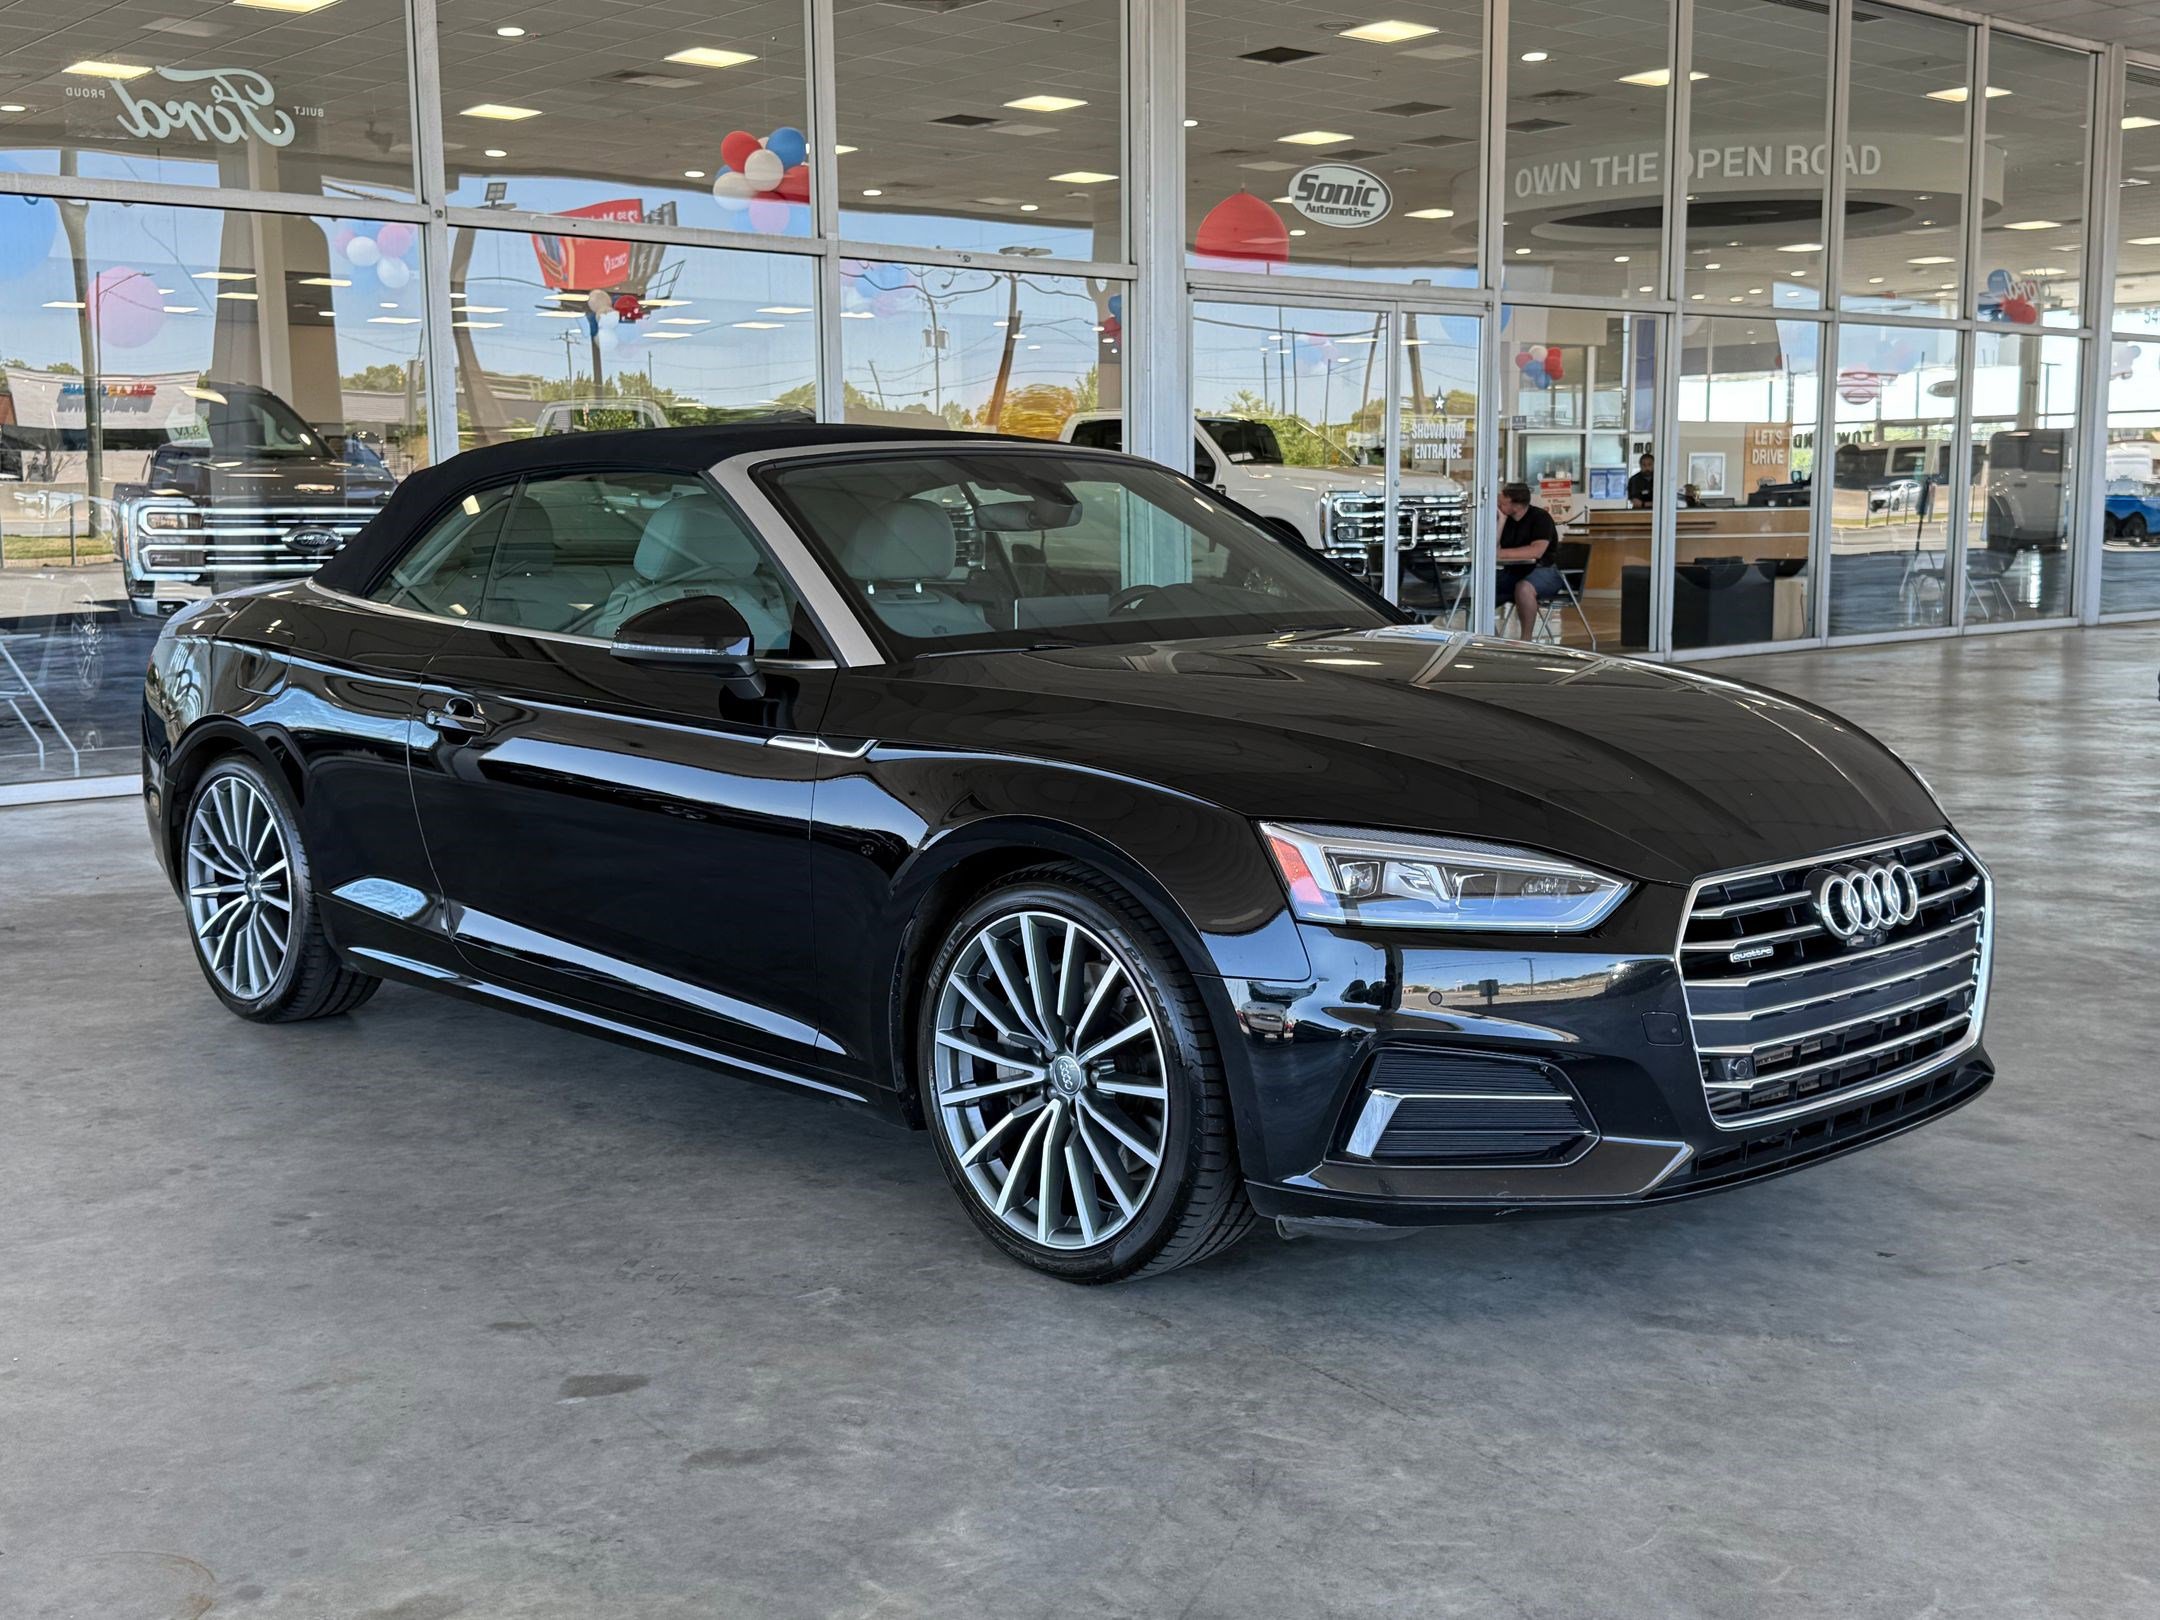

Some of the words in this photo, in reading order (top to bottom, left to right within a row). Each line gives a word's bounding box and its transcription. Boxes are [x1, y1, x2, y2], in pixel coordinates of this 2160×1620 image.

[1514, 160, 1581, 198] OWN
[1590, 152, 1659, 187] THE
[1686, 145, 1772, 179] PEN
[1295, 173, 1380, 208] Sonic
[1304, 202, 1371, 218] Automotive
[1411, 421, 1467, 439] SHOWROOM
[1754, 429, 1783, 445] LET'S
[1414, 443, 1462, 459] ENTRANCE
[1752, 448, 1785, 465] DRIVE
[1733, 947, 1773, 960] quattro
